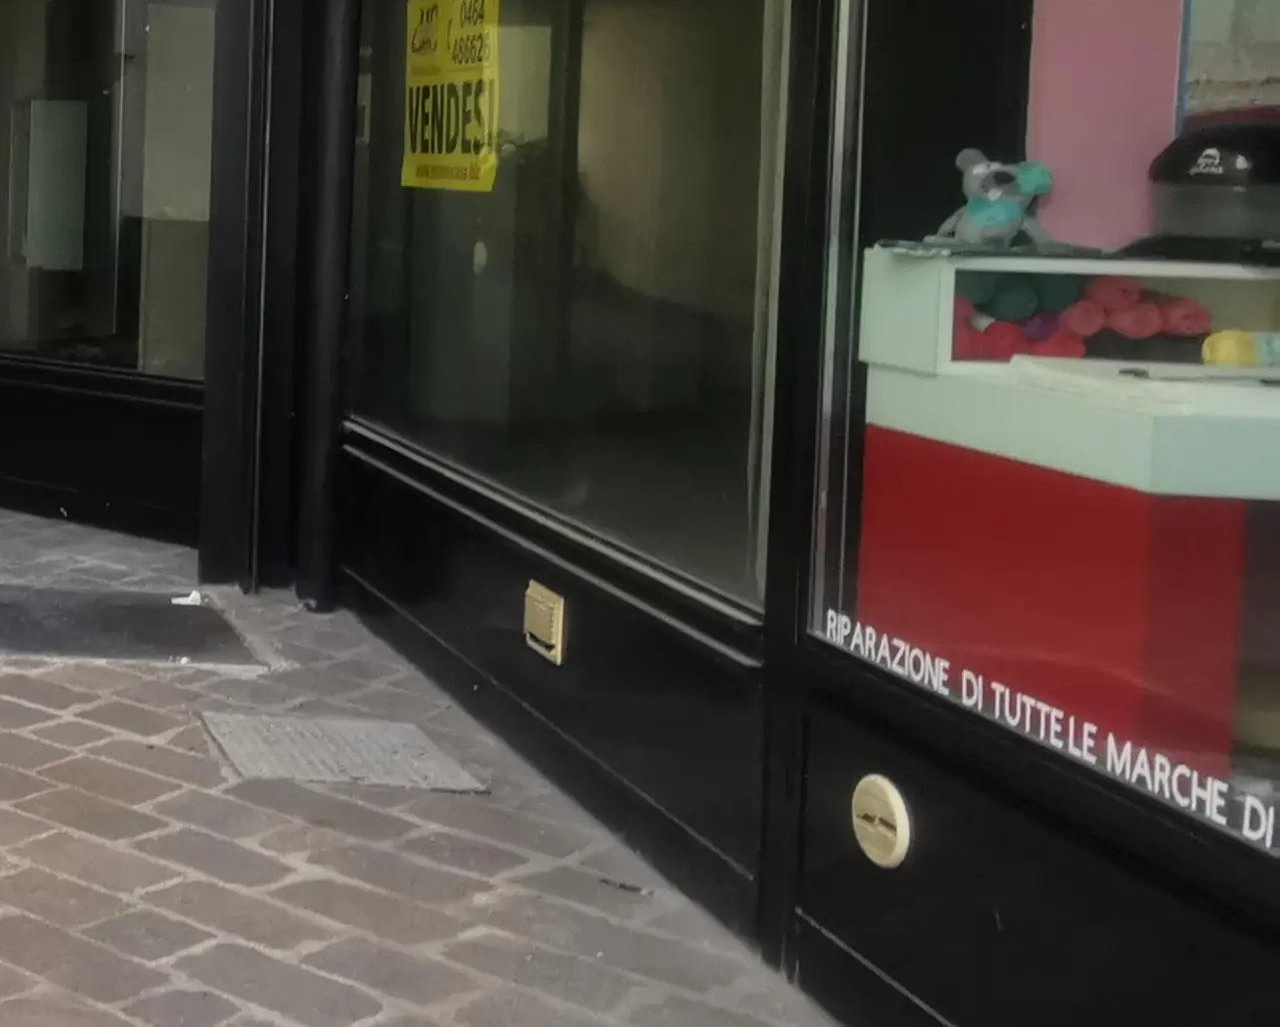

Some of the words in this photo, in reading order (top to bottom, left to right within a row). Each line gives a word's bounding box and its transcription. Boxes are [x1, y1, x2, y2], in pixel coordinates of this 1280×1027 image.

[826, 608, 950, 696] RIPARAZIONE
[961, 668, 984, 711] DI
[991, 680, 1065, 750] TUTTE
[1068, 715, 1098, 766] LE
[1106, 732, 1229, 826] MARCHE
[1242, 794, 1276, 850] DI
